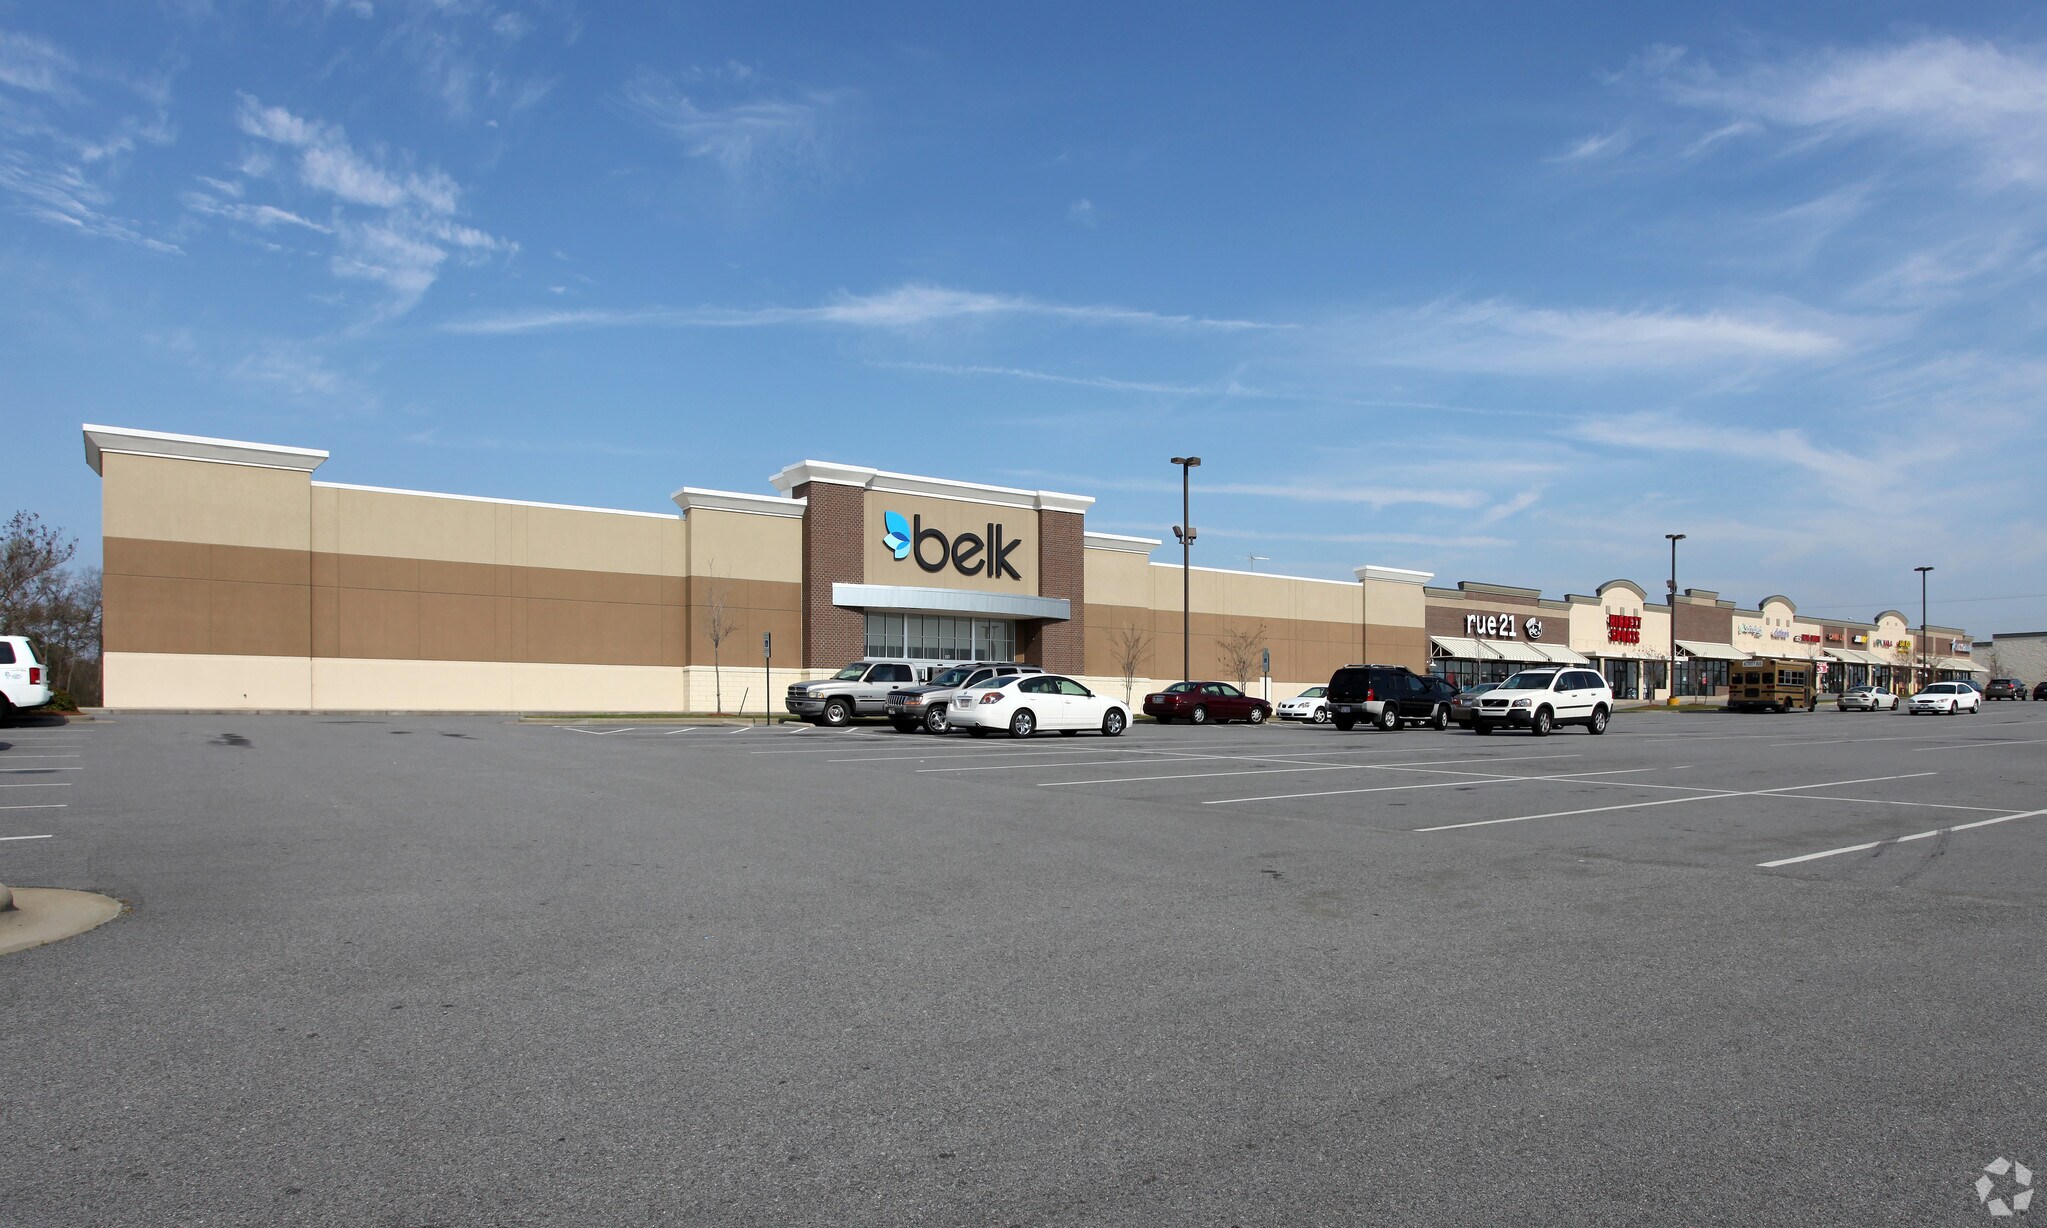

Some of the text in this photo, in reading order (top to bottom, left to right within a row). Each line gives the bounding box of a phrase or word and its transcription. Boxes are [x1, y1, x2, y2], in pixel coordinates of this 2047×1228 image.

[913, 513, 1022, 581] belk
[1609, 614, 1642, 629] HIBBETT
[1611, 629, 1640, 644] SPORTS
